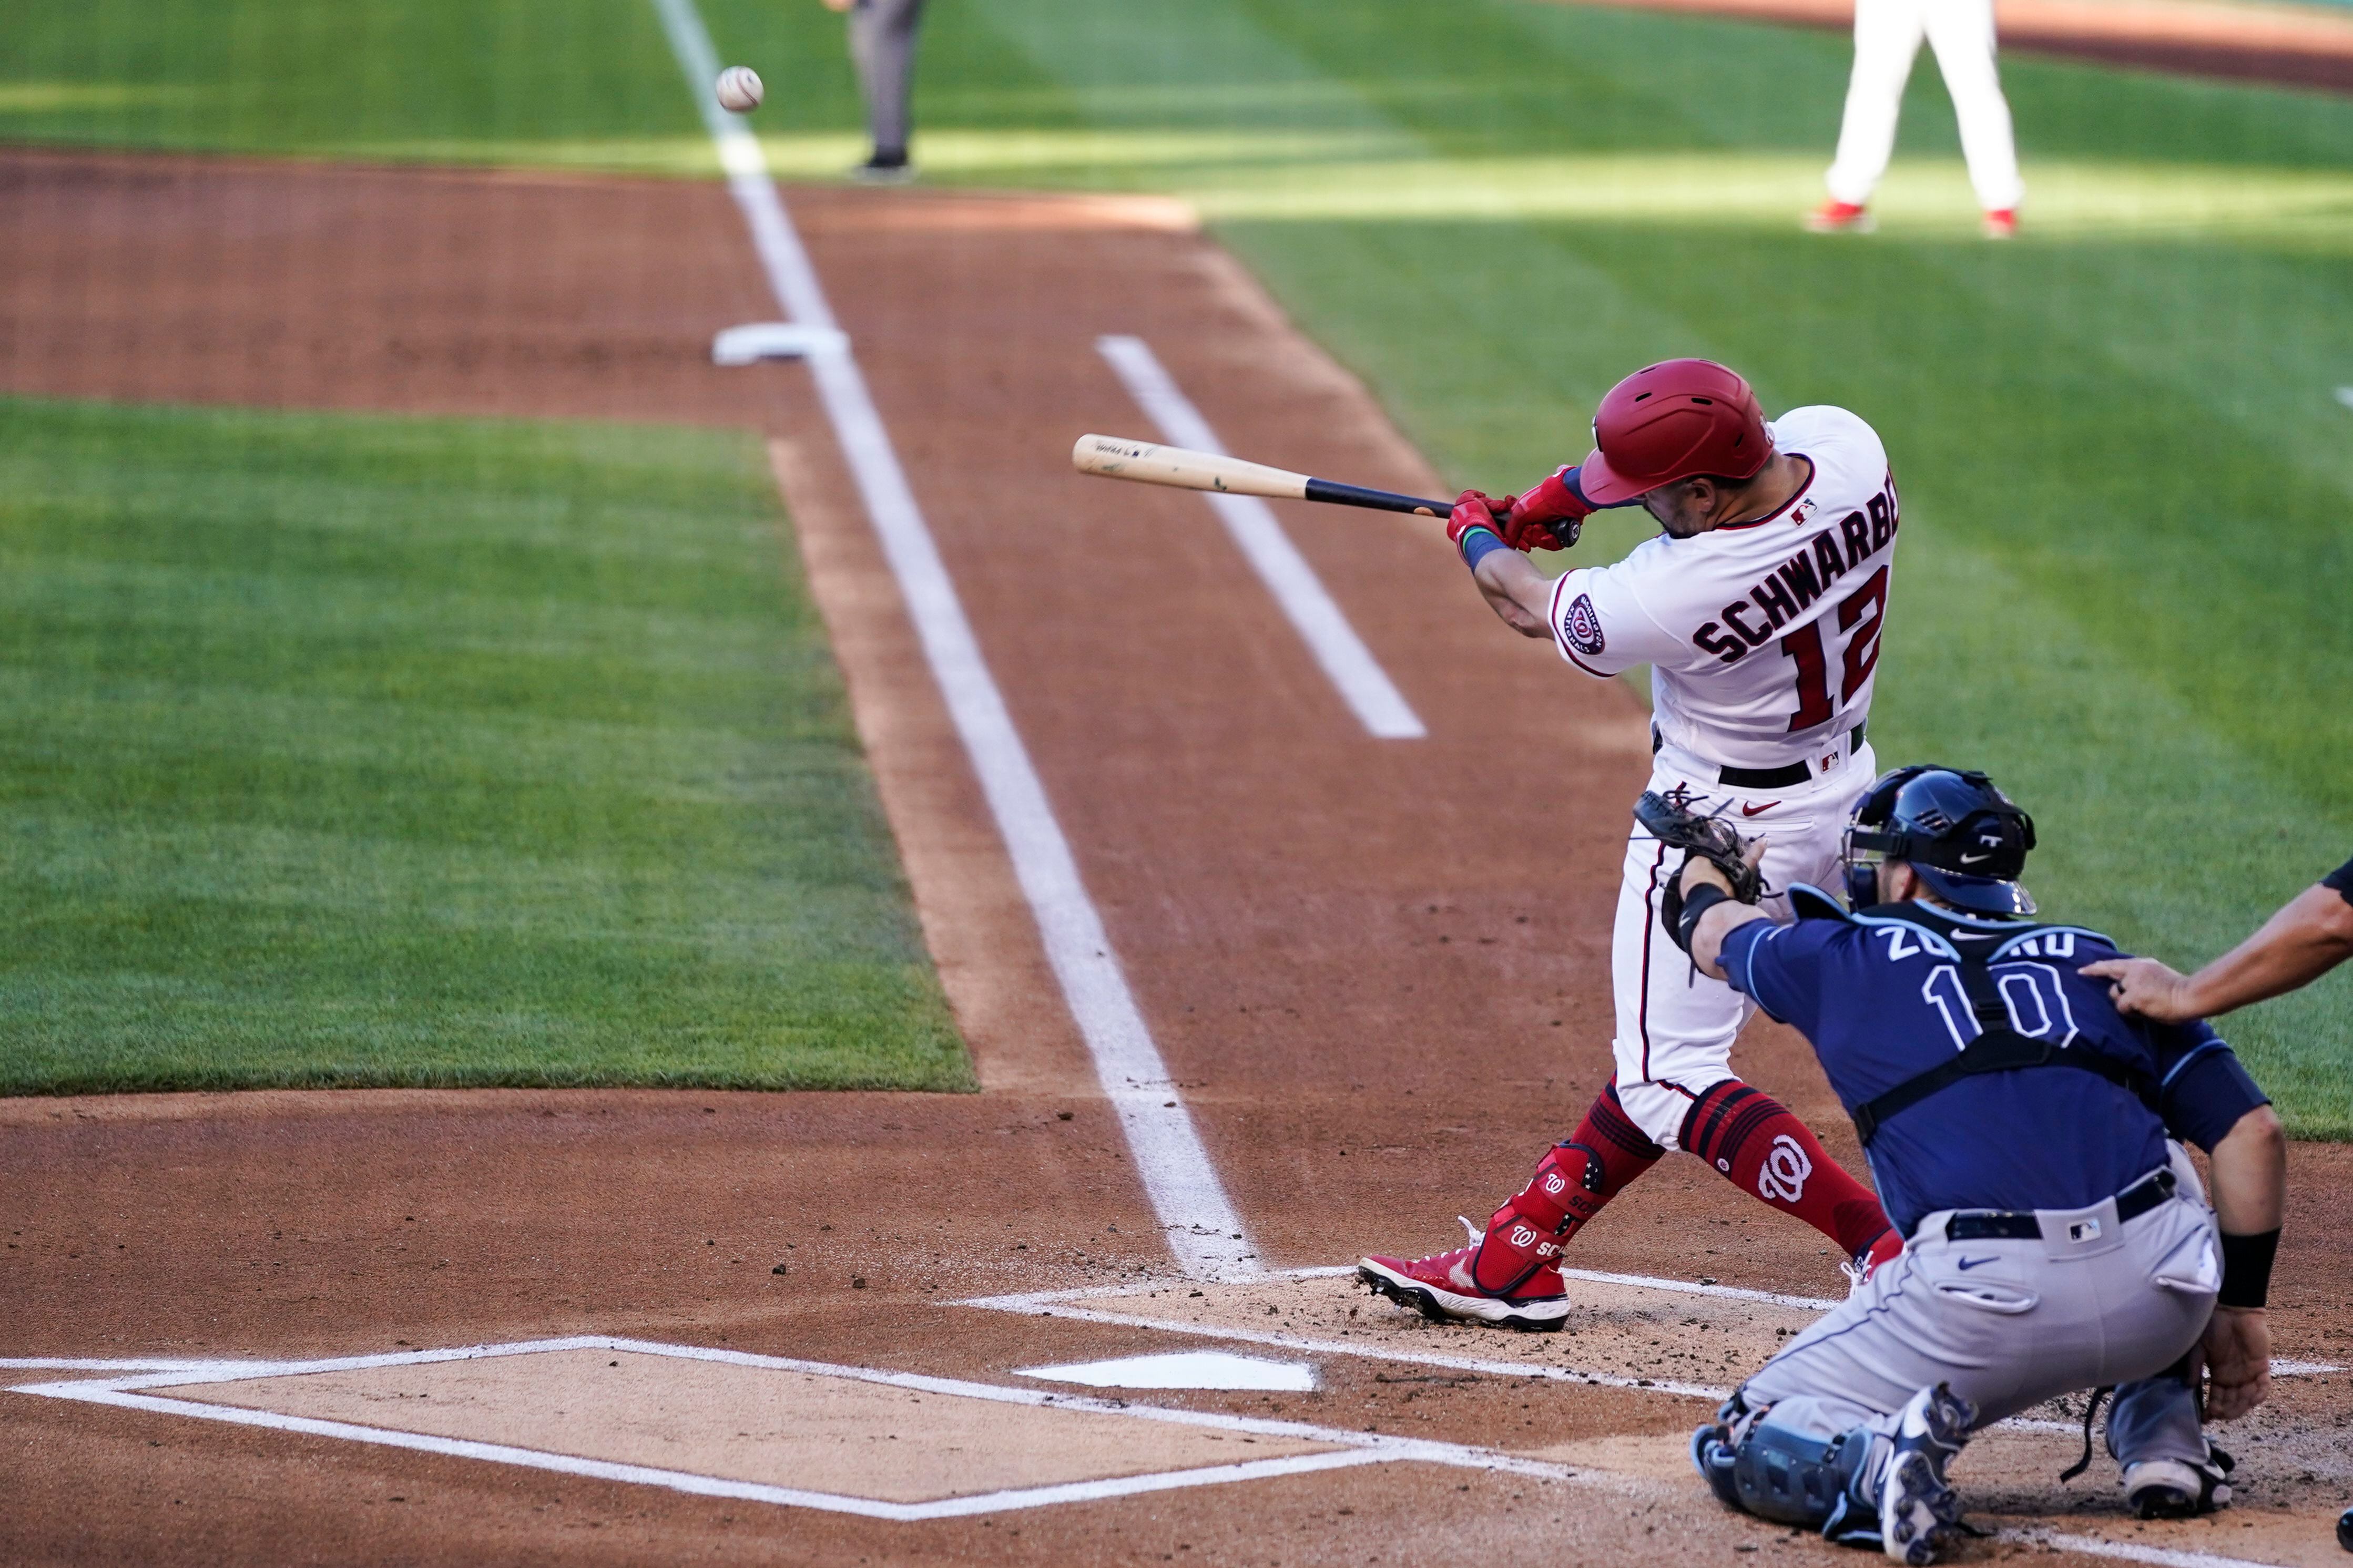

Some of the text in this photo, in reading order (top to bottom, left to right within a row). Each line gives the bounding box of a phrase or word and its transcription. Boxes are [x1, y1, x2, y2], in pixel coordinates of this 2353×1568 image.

[1565, 605, 1590, 652] NATIONALS
[1580, 596, 1603, 648] WASHINGTON
[1781, 564, 1889, 732] 12
[1921, 961, 2080, 1051] 10
[1545, 1173, 1565, 1194] W
[1758, 1134, 1812, 1203] W
[1511, 1225, 1537, 1247] W
